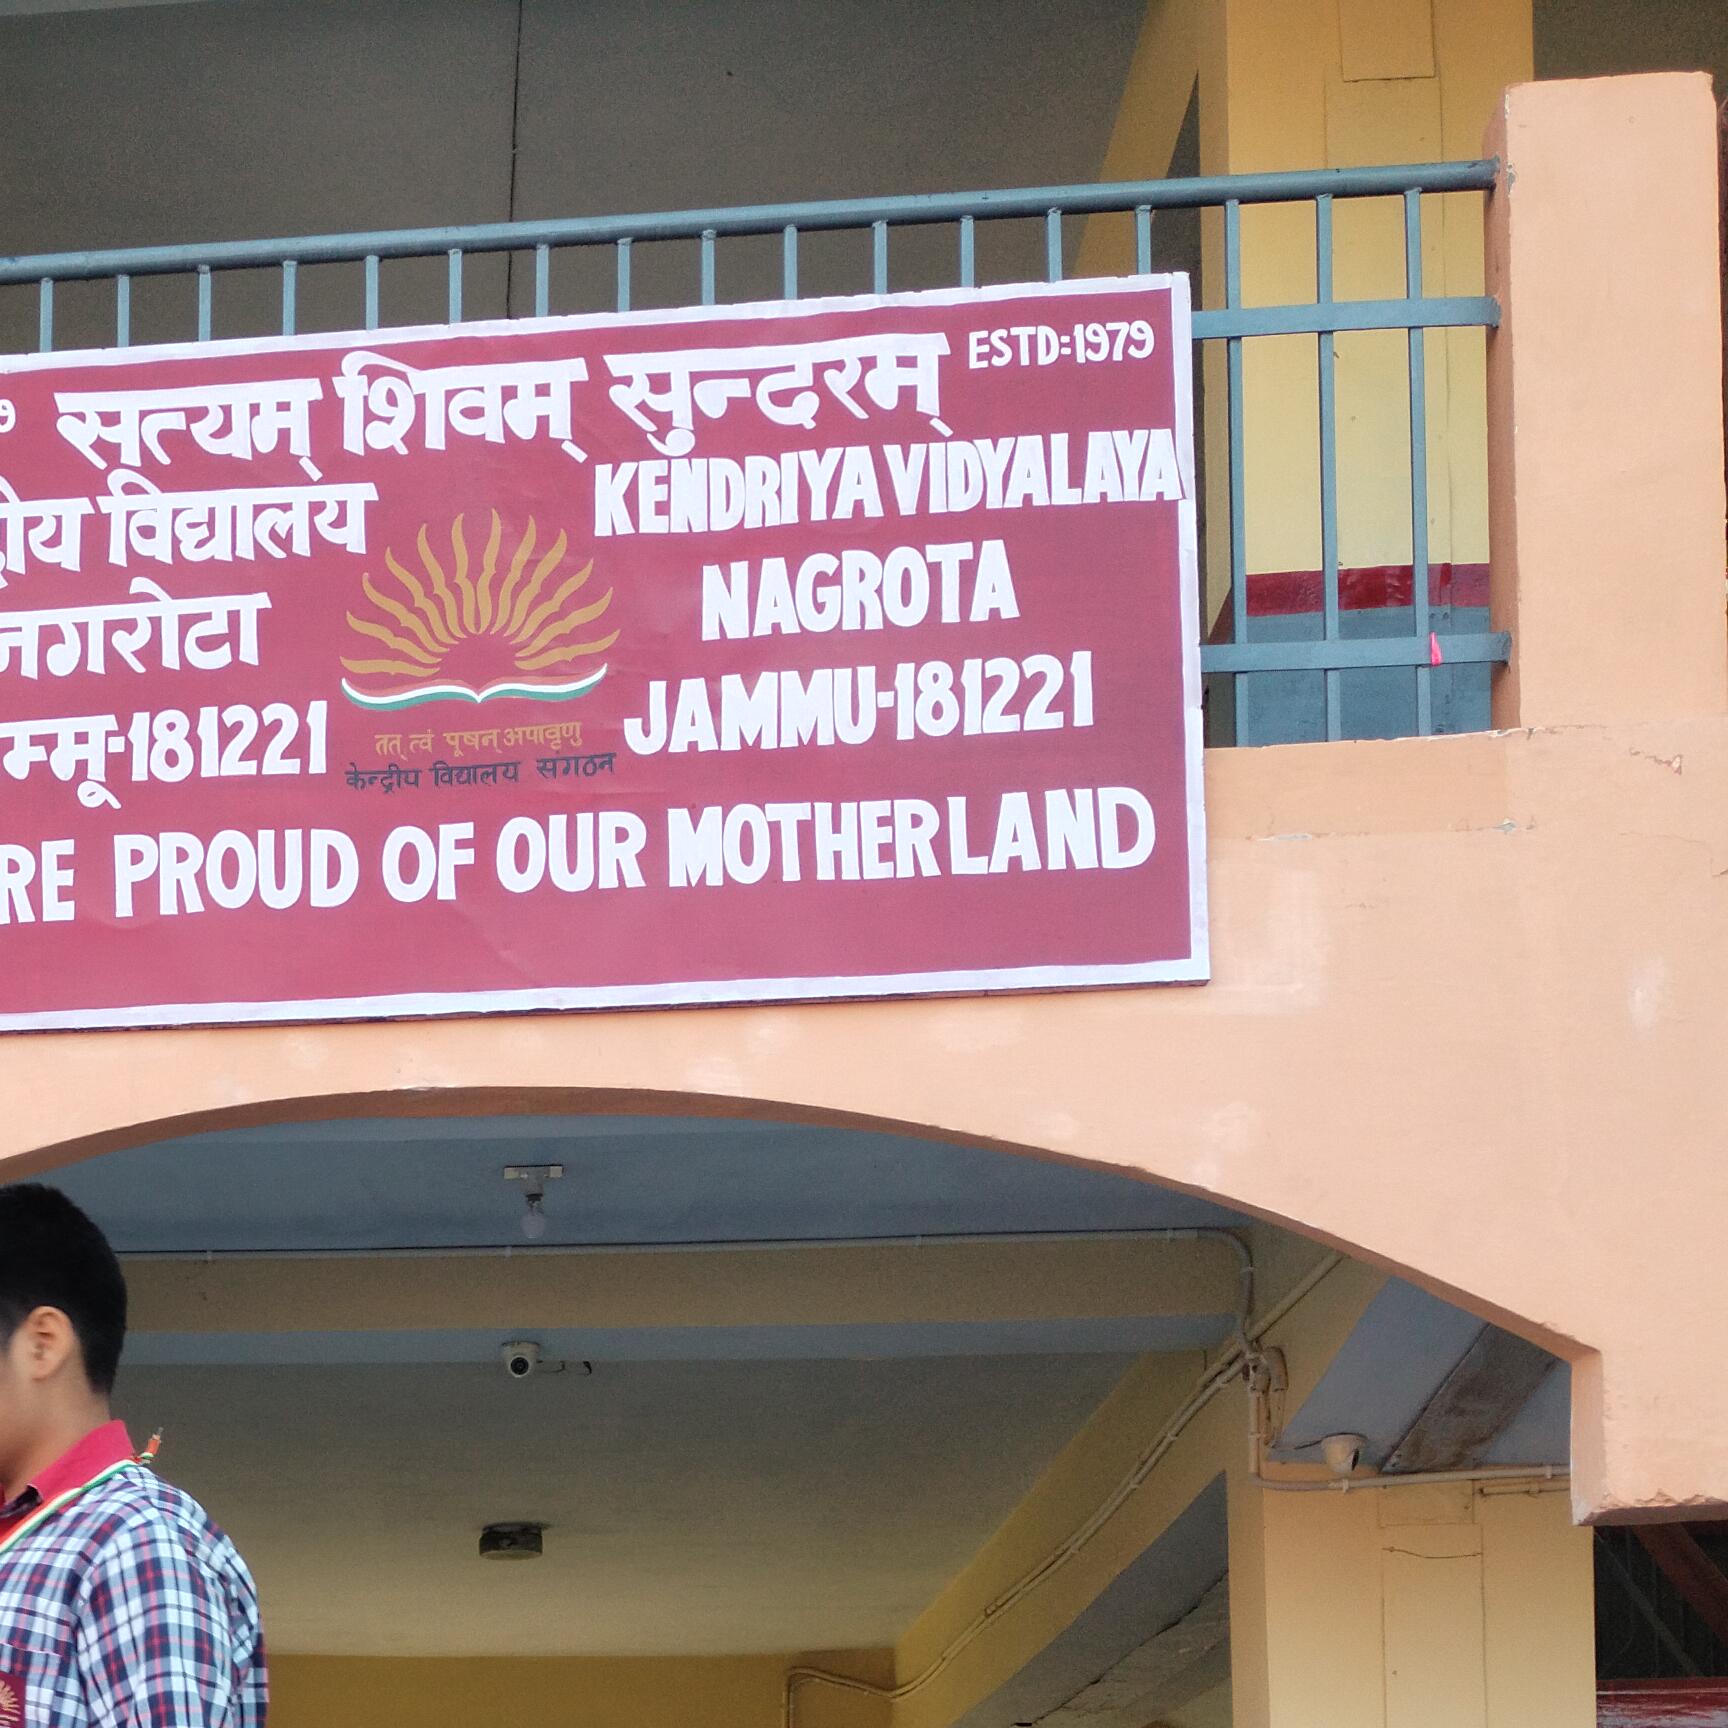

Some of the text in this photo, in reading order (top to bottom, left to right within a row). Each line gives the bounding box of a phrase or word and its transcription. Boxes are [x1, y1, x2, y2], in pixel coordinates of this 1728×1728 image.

[54, 378, 323, 483] सत्यम्
[333, 350, 587, 463] शिवम्
[604, 333, 950, 457] सुन्दरम्
[96, 469, 378, 568] विद्यालय
[593, 428, 1183, 537] KENDRIYA VIDYALAYA
[701, 539, 1020, 642] NAGROTA
[624, 650, 1094, 755] JAMMU-181221
[113, 828, 359, 918] PROUD
[381, 822, 475, 902] OF
[496, 811, 647, 893] OUR
[668, 786, 1157, 888] MOTHERLAND
